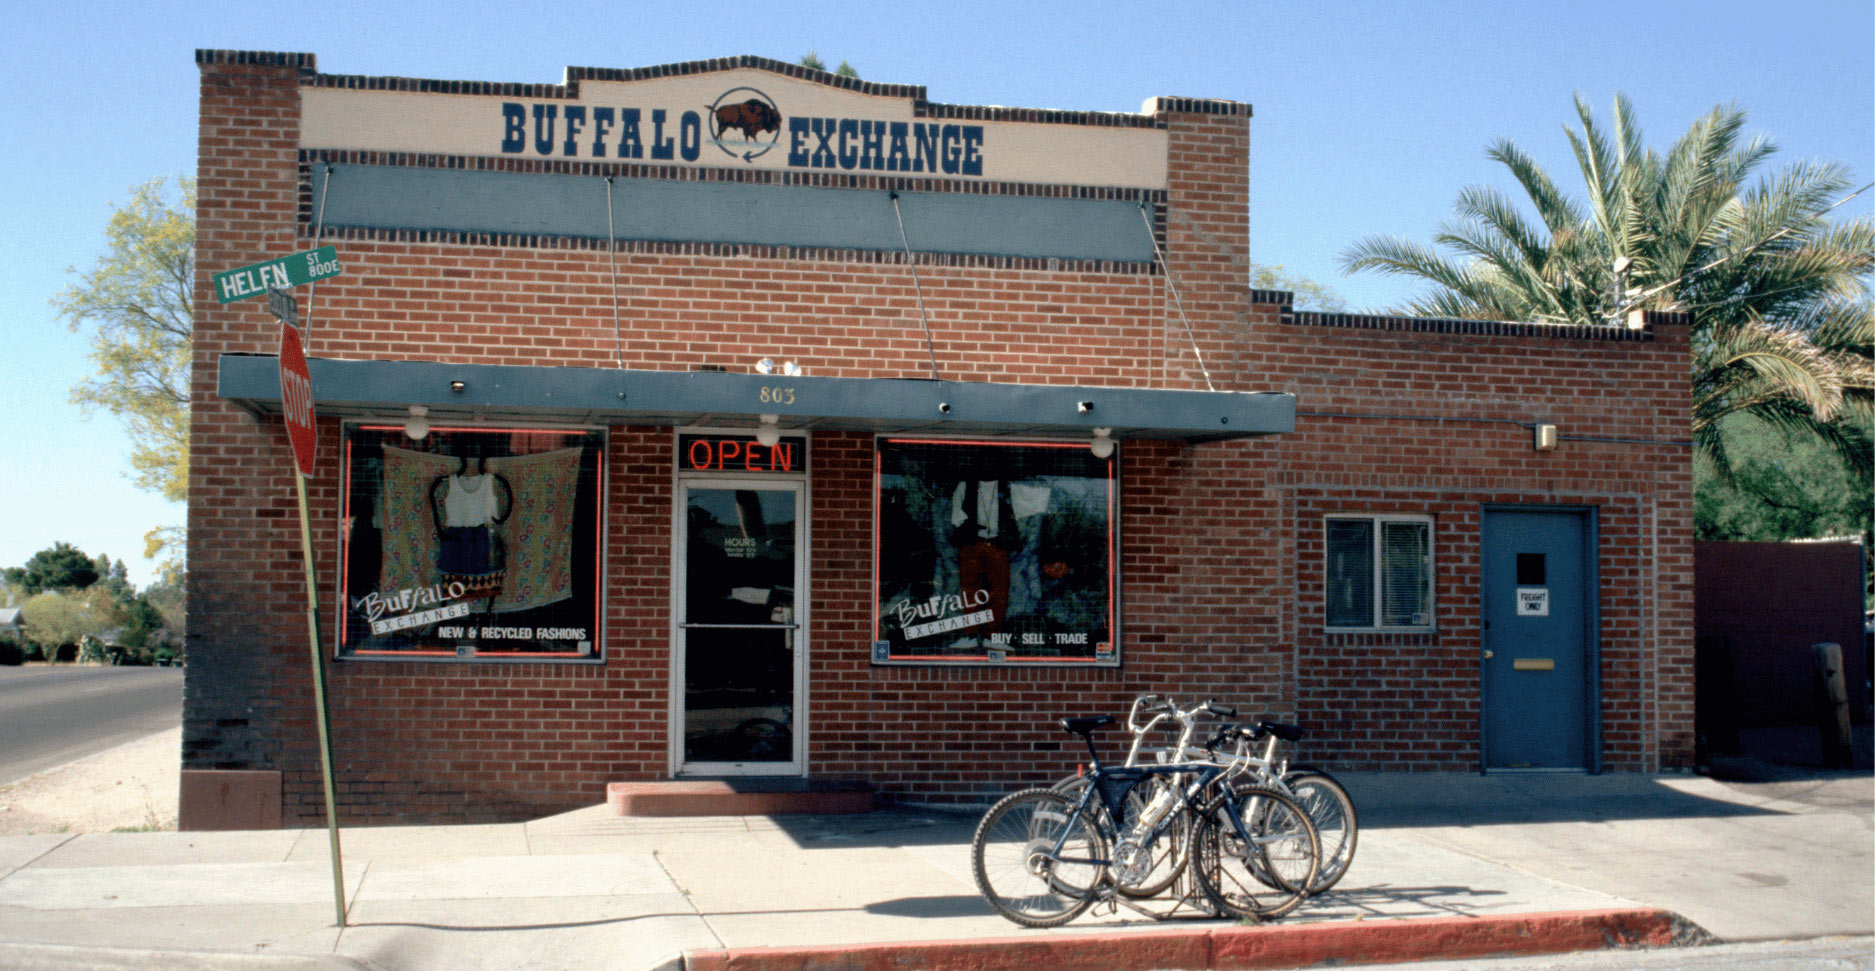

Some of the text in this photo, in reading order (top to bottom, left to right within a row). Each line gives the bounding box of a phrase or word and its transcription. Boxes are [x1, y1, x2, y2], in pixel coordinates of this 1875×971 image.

[502, 103, 983, 176] BUFFALO EXCHANGE
[306, 252, 319, 265] ST
[308, 260, 339, 277] 800E
[221, 262, 290, 298] HELEN
[283, 366, 312, 430] STOP
[760, 386, 795, 405] 803
[690, 440, 791, 471] OPEN
[724, 537, 756, 547] HOURS
[1520, 593, 1546, 602] FREIGHT
[1525, 602, 1541, 611] ONLY
[373, 603, 469, 634] EXCHANGE
[905, 610, 993, 639] EXCHANGE
[438, 626, 587, 640] NEW & RECYCLED FASHIONS
[991, 632, 1088, 645] BUY SELL TRADE
